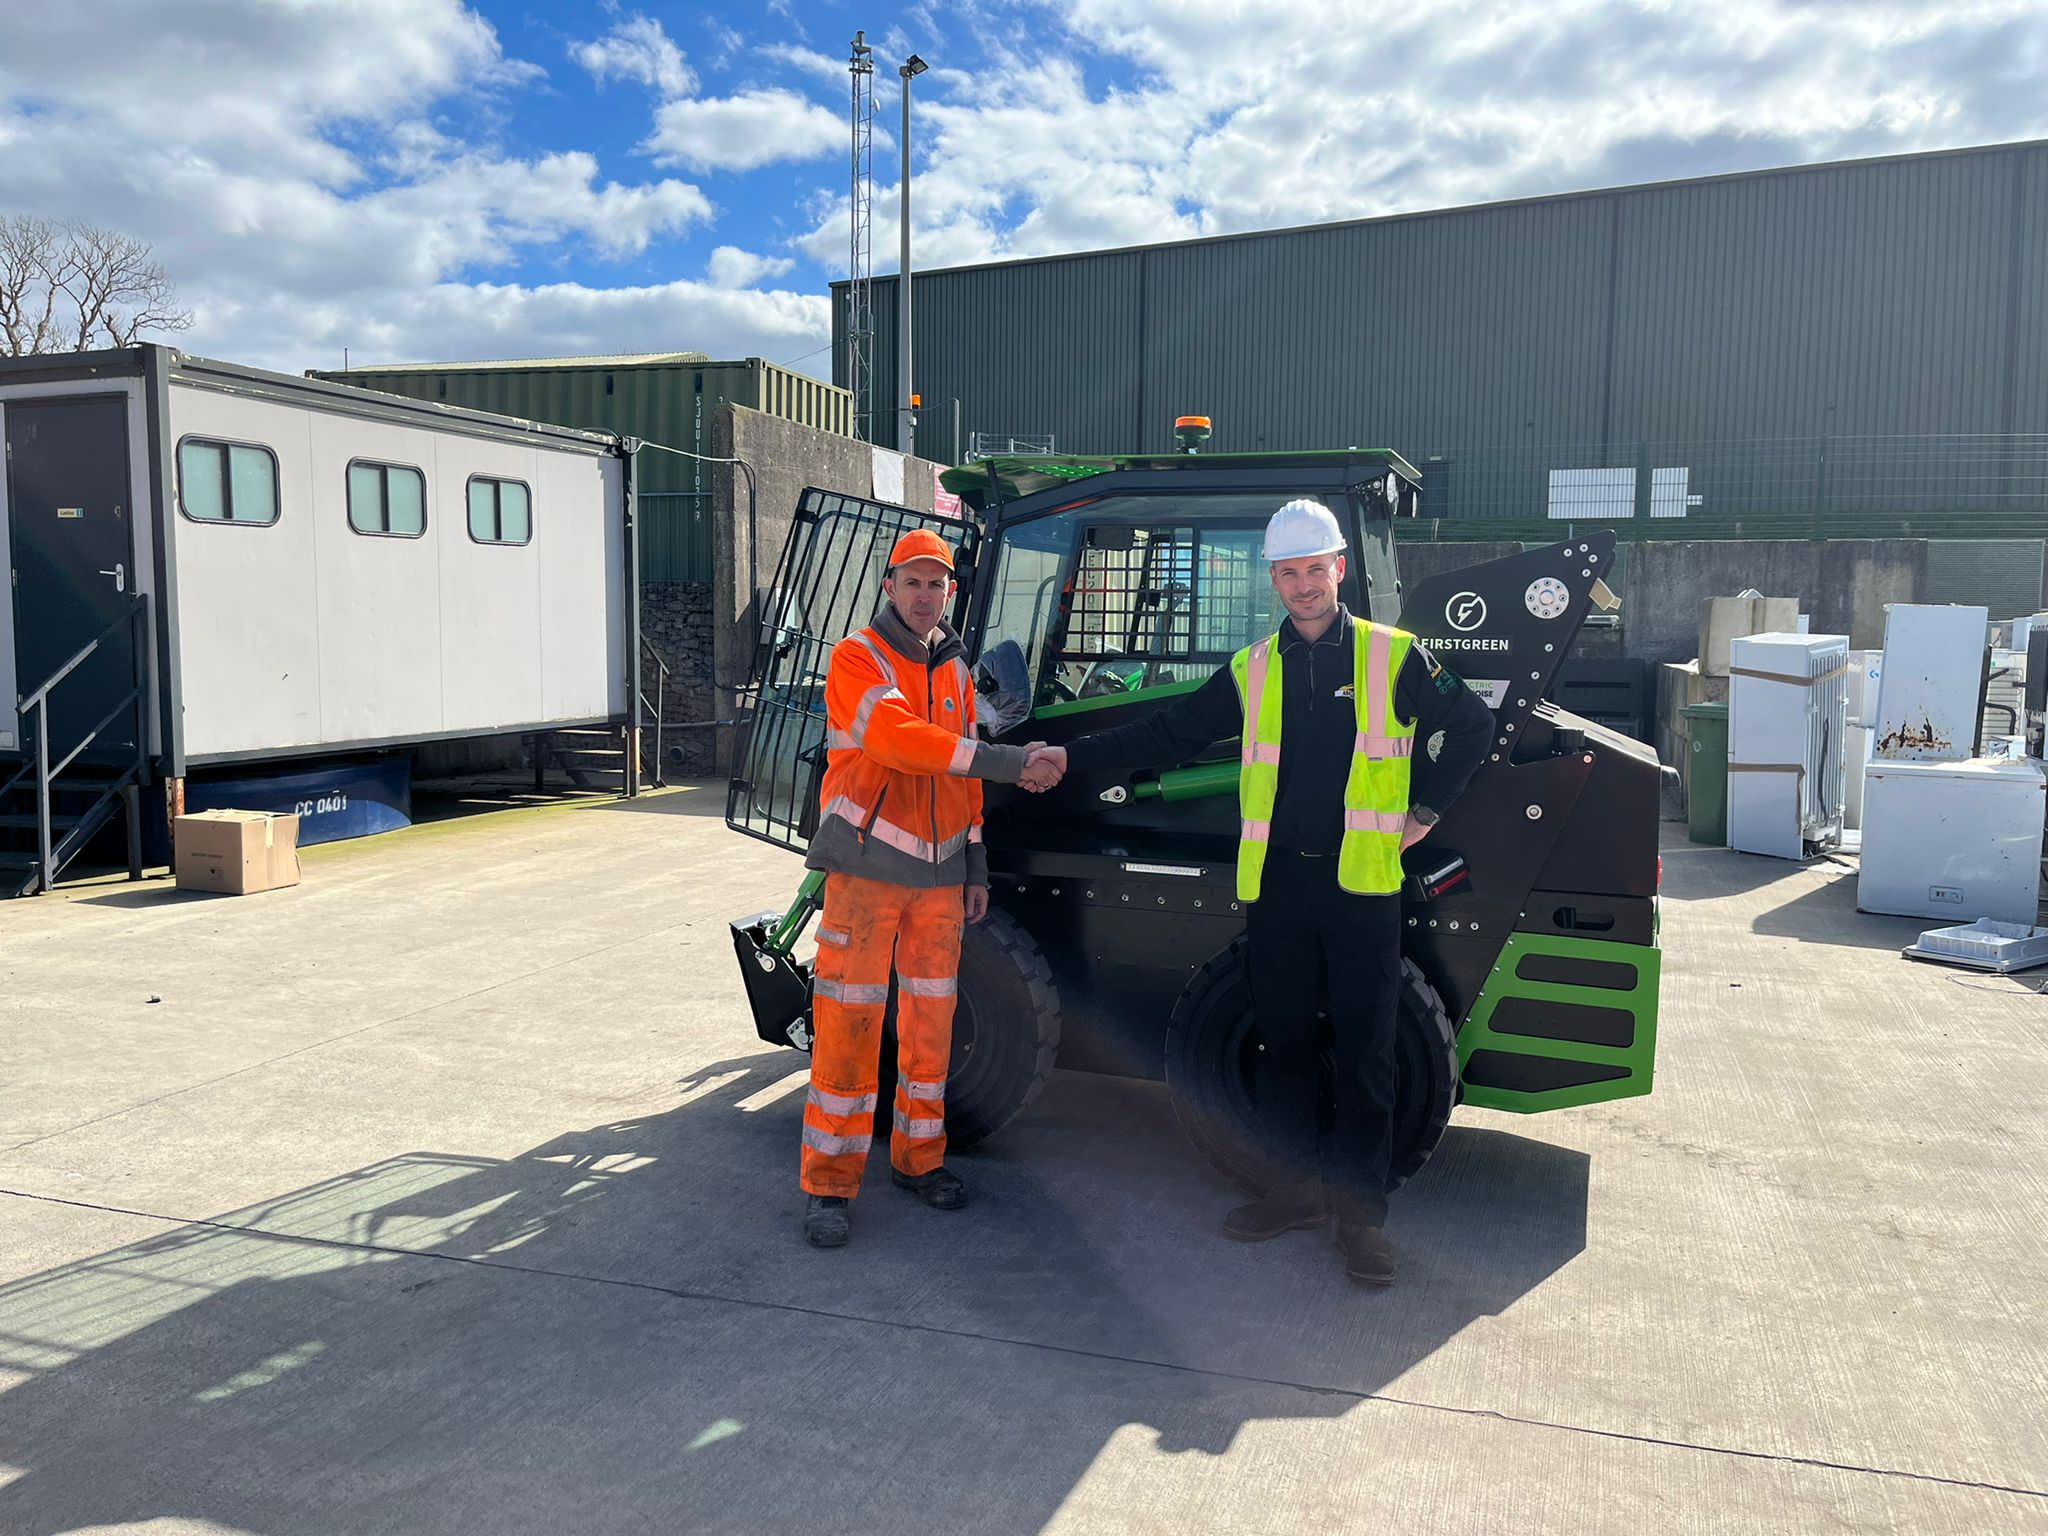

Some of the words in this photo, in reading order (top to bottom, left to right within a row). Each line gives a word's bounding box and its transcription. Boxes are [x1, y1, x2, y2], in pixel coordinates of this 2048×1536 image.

[1421, 638, 1509, 650] FIRSTGREEN
[1475, 690, 1493, 698] OISE
[295, 800, 313, 816] CC
